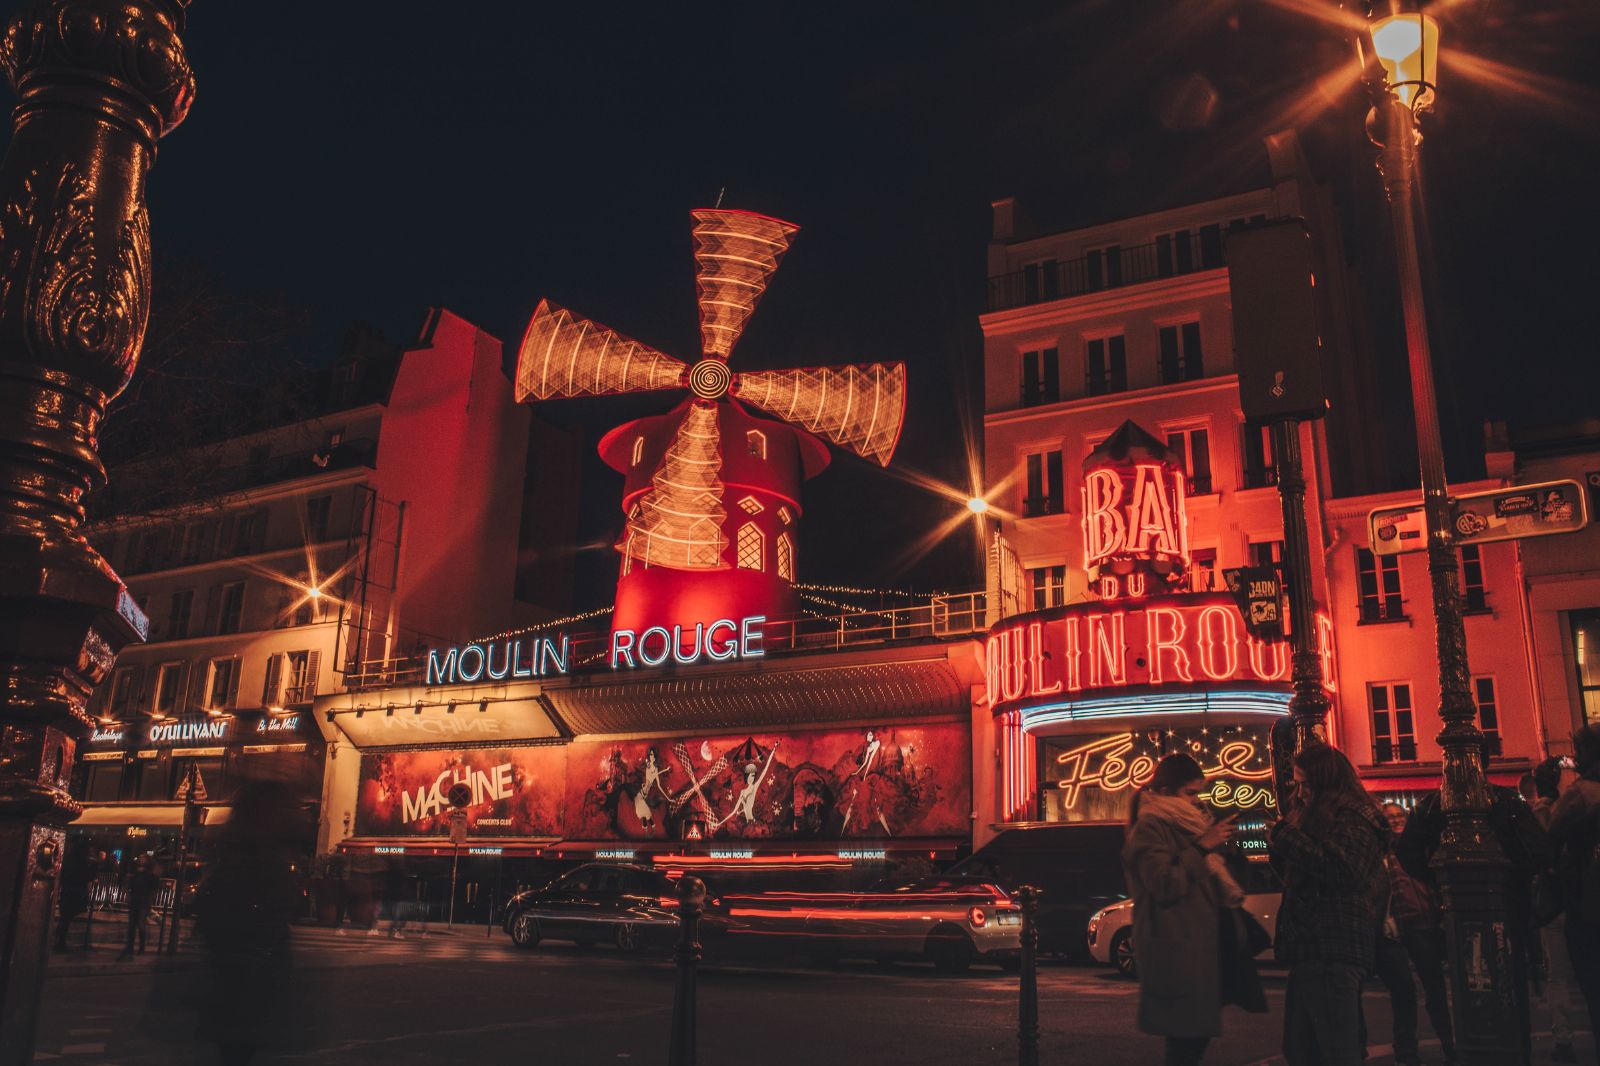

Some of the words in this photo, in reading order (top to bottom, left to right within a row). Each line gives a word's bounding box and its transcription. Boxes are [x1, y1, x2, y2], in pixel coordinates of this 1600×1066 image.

[1082, 465, 1190, 569] BA
[1101, 573, 1145, 600] DU
[426, 636, 570, 685] MOULIN
[611, 615, 767, 669] ROUGE
[985, 610, 1127, 707] OULIN
[1146, 604, 1337, 694] ROUE
[401, 762, 514, 824] MACHINE
[1057, 731, 1273, 809] Féee
